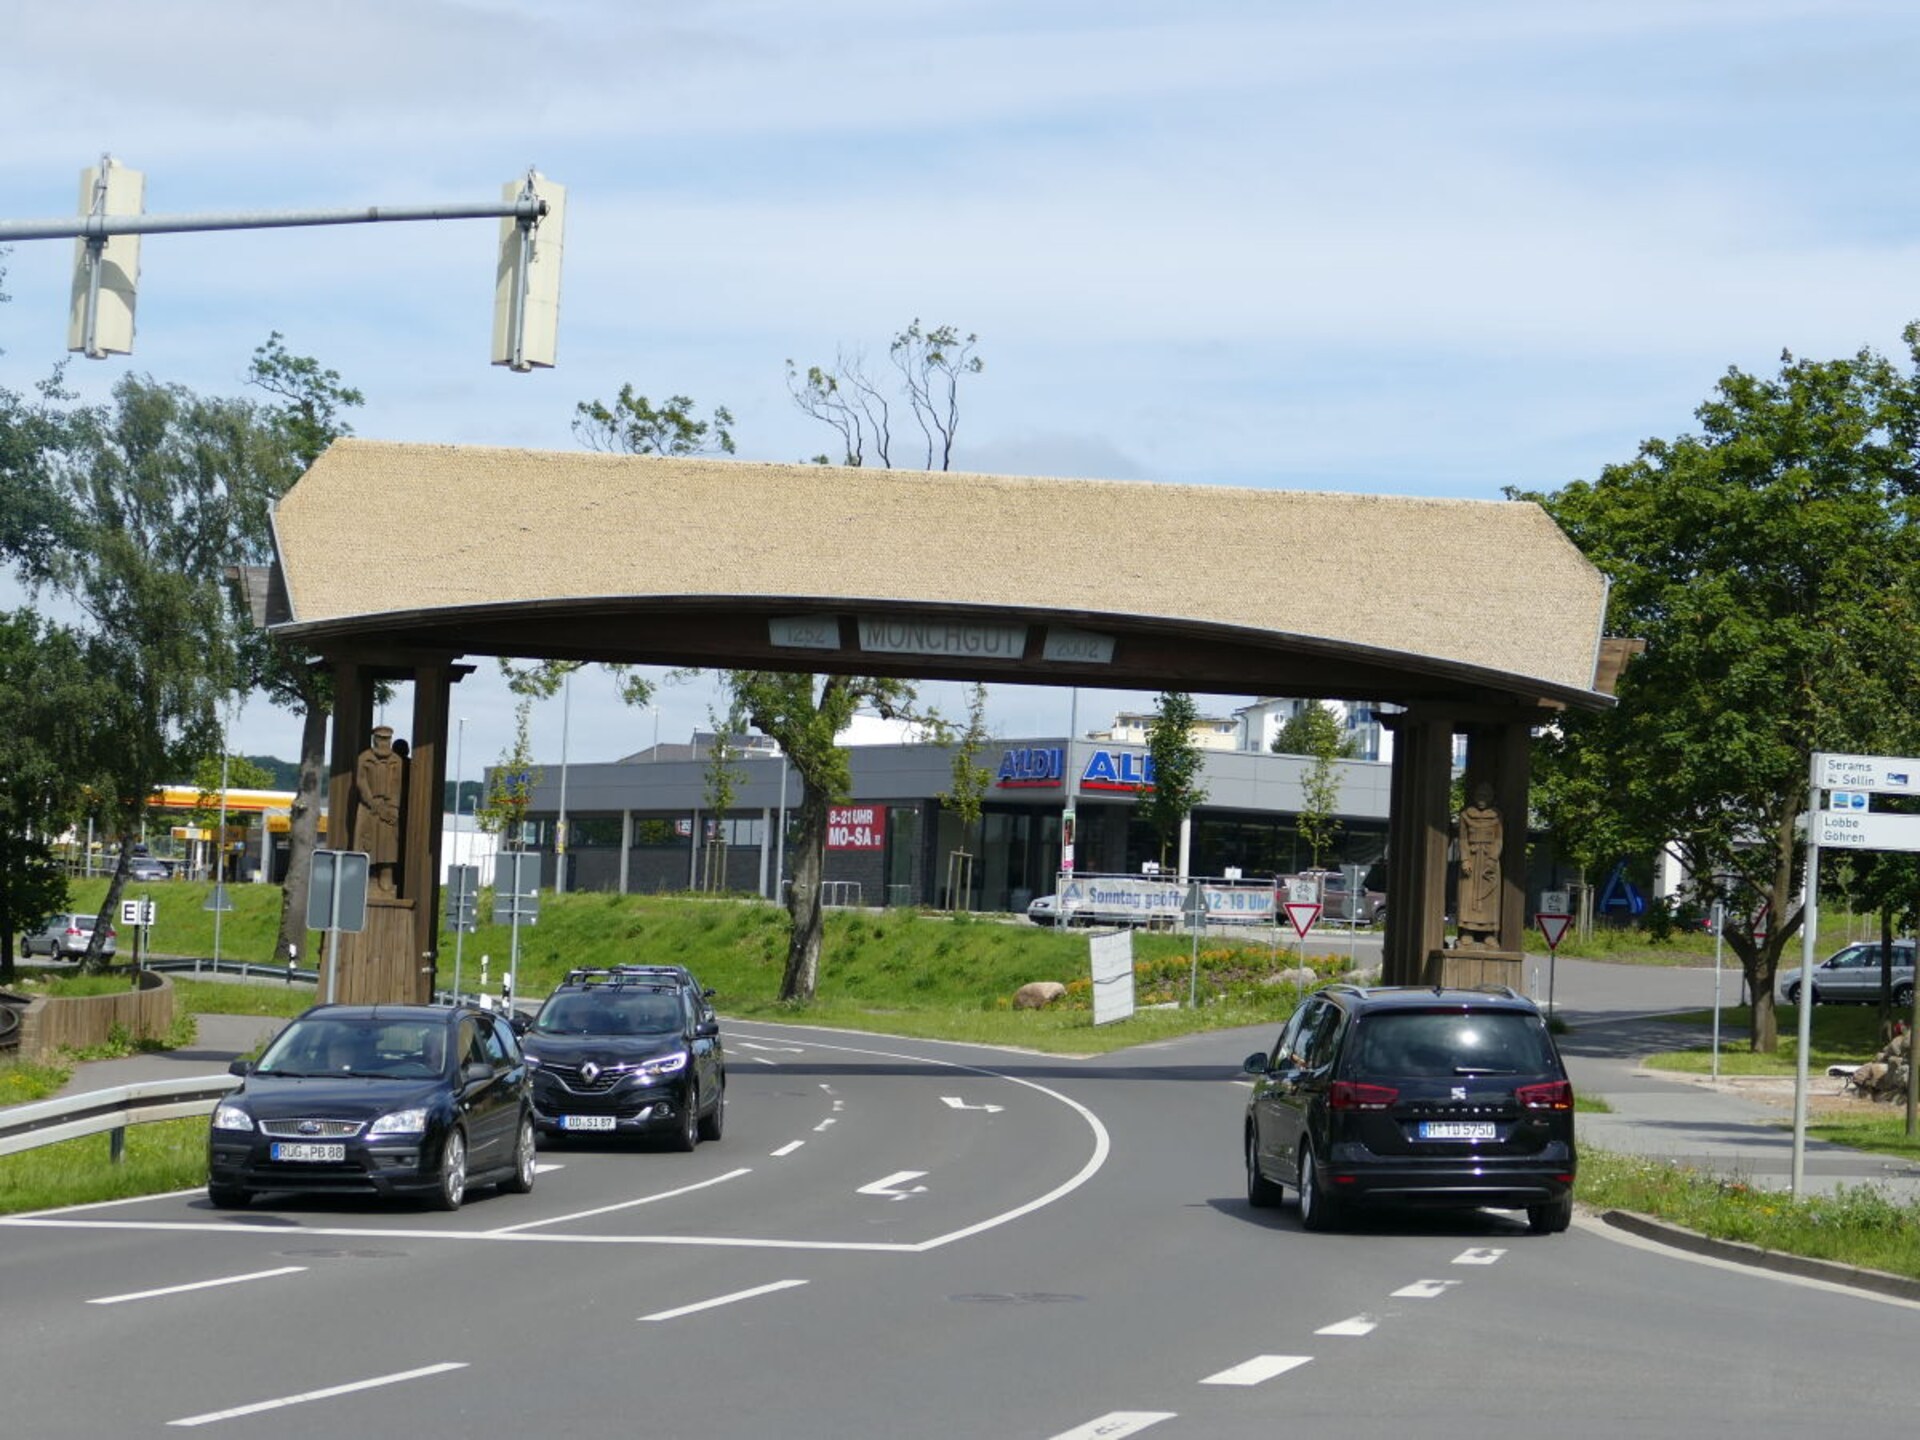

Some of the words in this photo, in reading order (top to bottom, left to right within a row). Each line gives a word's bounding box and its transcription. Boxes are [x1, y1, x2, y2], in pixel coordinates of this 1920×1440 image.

[997, 748, 1063, 780] ALDI
[1083, 750, 1157, 784] AL
[1828, 760, 1872, 772] Serams
[1842, 774, 1875, 786] Sellin
[852, 809, 873, 825] UHR
[1825, 816, 1860, 828] Lobbe
[828, 827, 872, 846] MO-SA
[1825, 830, 1865, 843] Göhren
[1089, 886, 1141, 908] Sonntag
[1249, 893, 1271, 910] Uhr
